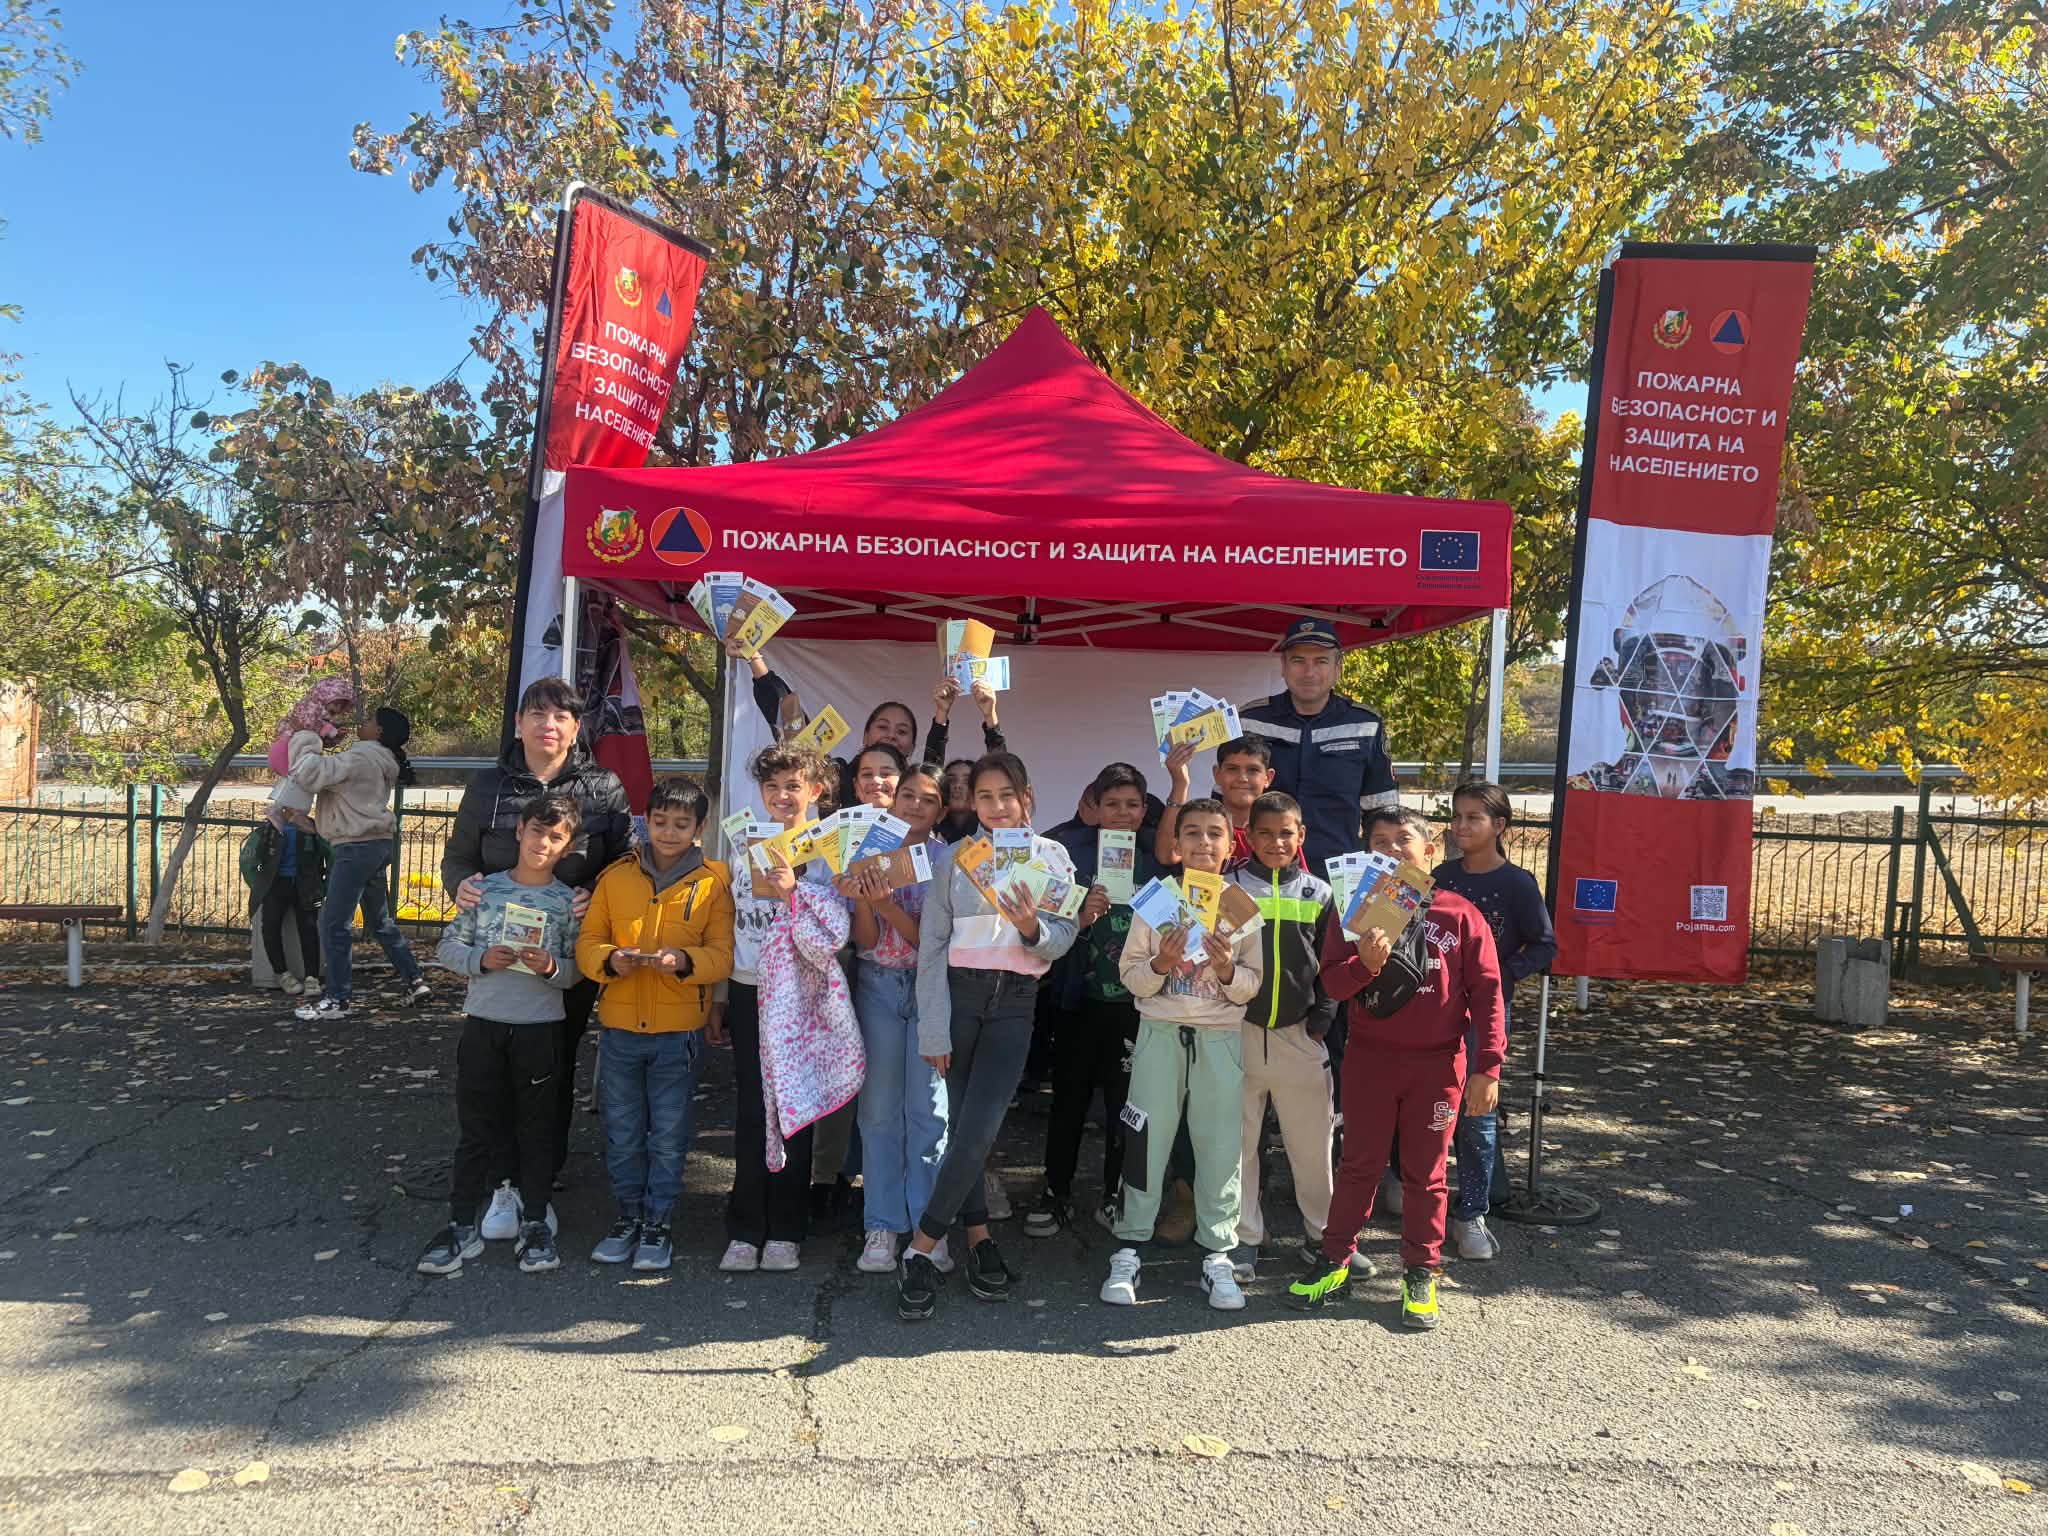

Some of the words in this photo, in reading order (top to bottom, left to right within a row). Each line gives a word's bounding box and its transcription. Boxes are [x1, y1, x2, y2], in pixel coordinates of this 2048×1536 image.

[605, 321, 667, 368] ПОЖАРНА
[571, 342, 670, 398] БЕЗОПАСНОСТ
[1637, 371, 1742, 396] ПОЖАРНА
[594, 377, 649, 415] ЗАЩИТА
[648, 403, 661, 422] НА
[1611, 396, 1756, 426] БЕЗОПАСНОСТ
[1761, 409, 1777, 427] И
[1624, 427, 1711, 452] ЗАЩИТА
[1717, 435, 1745, 454] НА
[1609, 453, 1760, 483] НАСЕЛЕНИЕТО
[722, 529, 849, 554] ПОЖАРНА
[856, 535, 1041, 559] БЕЗОПАСНОСТ
[1049, 542, 1066, 560] И
[1072, 543, 1176, 565] ЗАЩИТА
[1183, 546, 1219, 565] НА
[1223, 546, 1407, 567] НАСЕЛЕНИЕТО
[1675, 921, 1736, 933] Pojama.com
